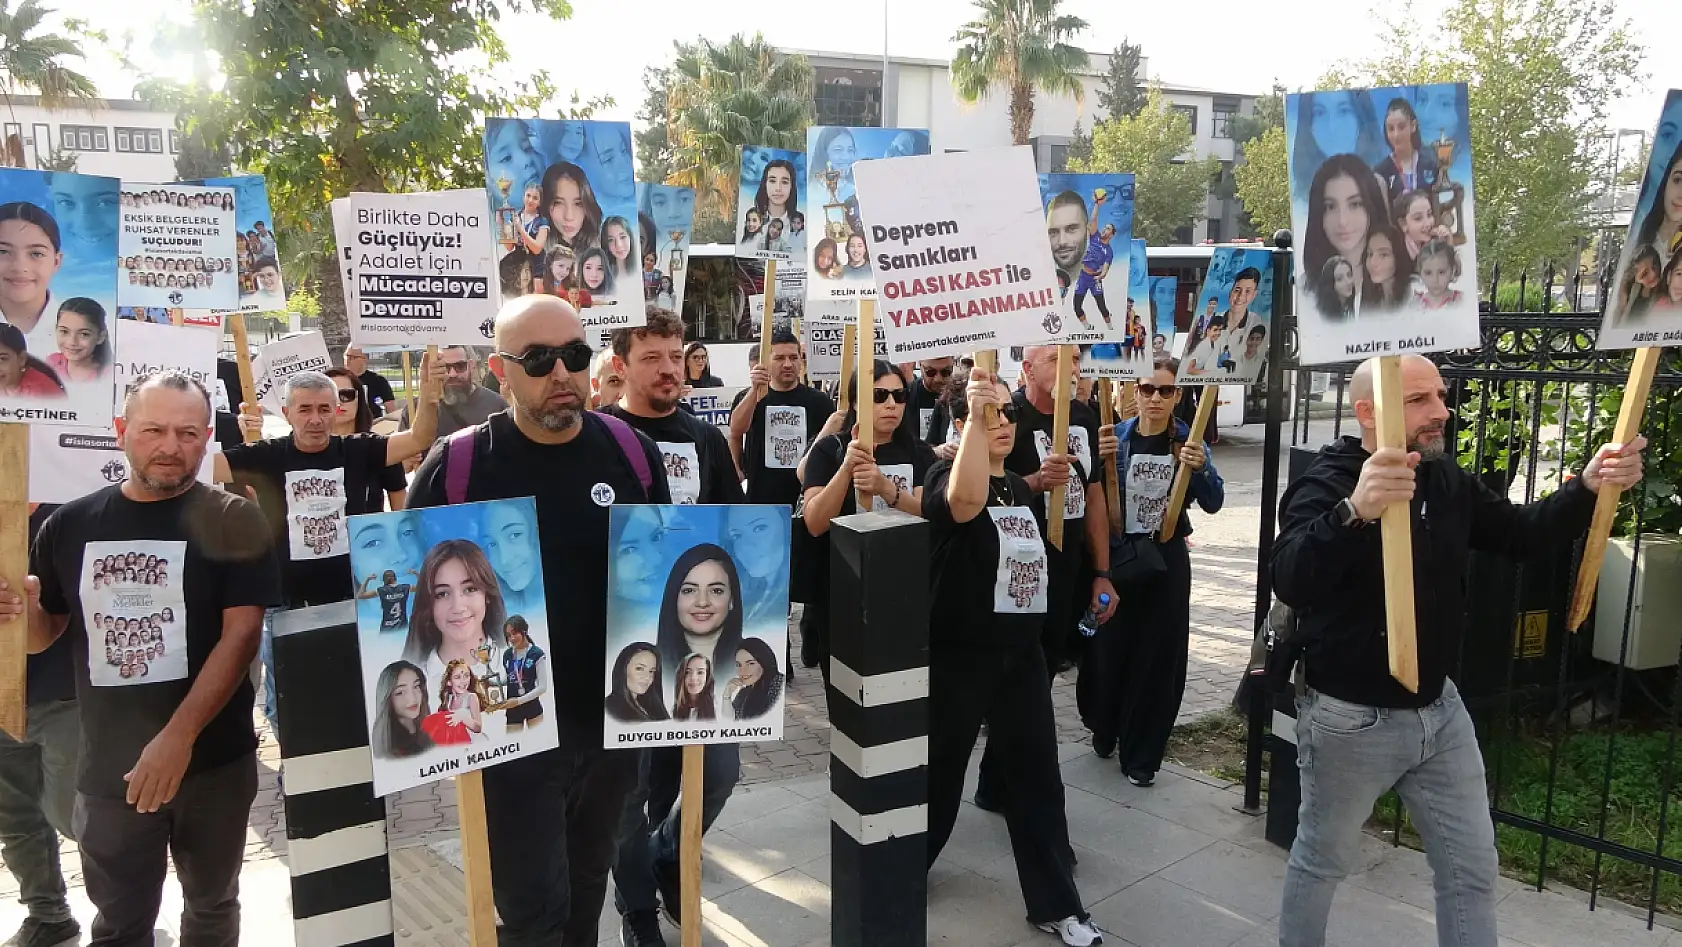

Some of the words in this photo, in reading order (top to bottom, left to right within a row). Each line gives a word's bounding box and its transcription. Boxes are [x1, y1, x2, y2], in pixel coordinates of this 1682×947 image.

[124, 212, 154, 223] EKSİK
[155, 215, 220, 226] BELGELERLE
[357, 208, 421, 225] Birlikte
[428, 212, 479, 227] Daha
[125, 225, 164, 234] RUHSAT
[167, 227, 220, 236] VERENLER
[872, 219, 959, 245] Deprem
[141, 237, 203, 247] SUÇLUDUR!
[358, 230, 462, 251] Güçlüyüz!
[359, 253, 423, 269] Adalet
[429, 253, 463, 274] İçin
[877, 245, 978, 271] Sanıkları
[360, 276, 486, 298] Mücadeleye
[883, 275, 946, 300] OLASI
[949, 268, 1003, 291] KAST
[1005, 264, 1032, 283] ile
[361, 301, 442, 317] Devam!
[888, 288, 1055, 328] YARGILANMALI!
[1663, 330, 1682, 341] DAĞ
[1345, 340, 1392, 355] NAZİFE
[1398, 336, 1436, 349] DAĞLI
[15, 408, 78, 421] ÇETİNER
[618, 732, 662, 742] DUYGU
[666, 729, 716, 740] BOLSOY
[720, 727, 772, 738] KALAYCI
[419, 758, 460, 777] LAVİN
[466, 742, 520, 765] KALAYCI
